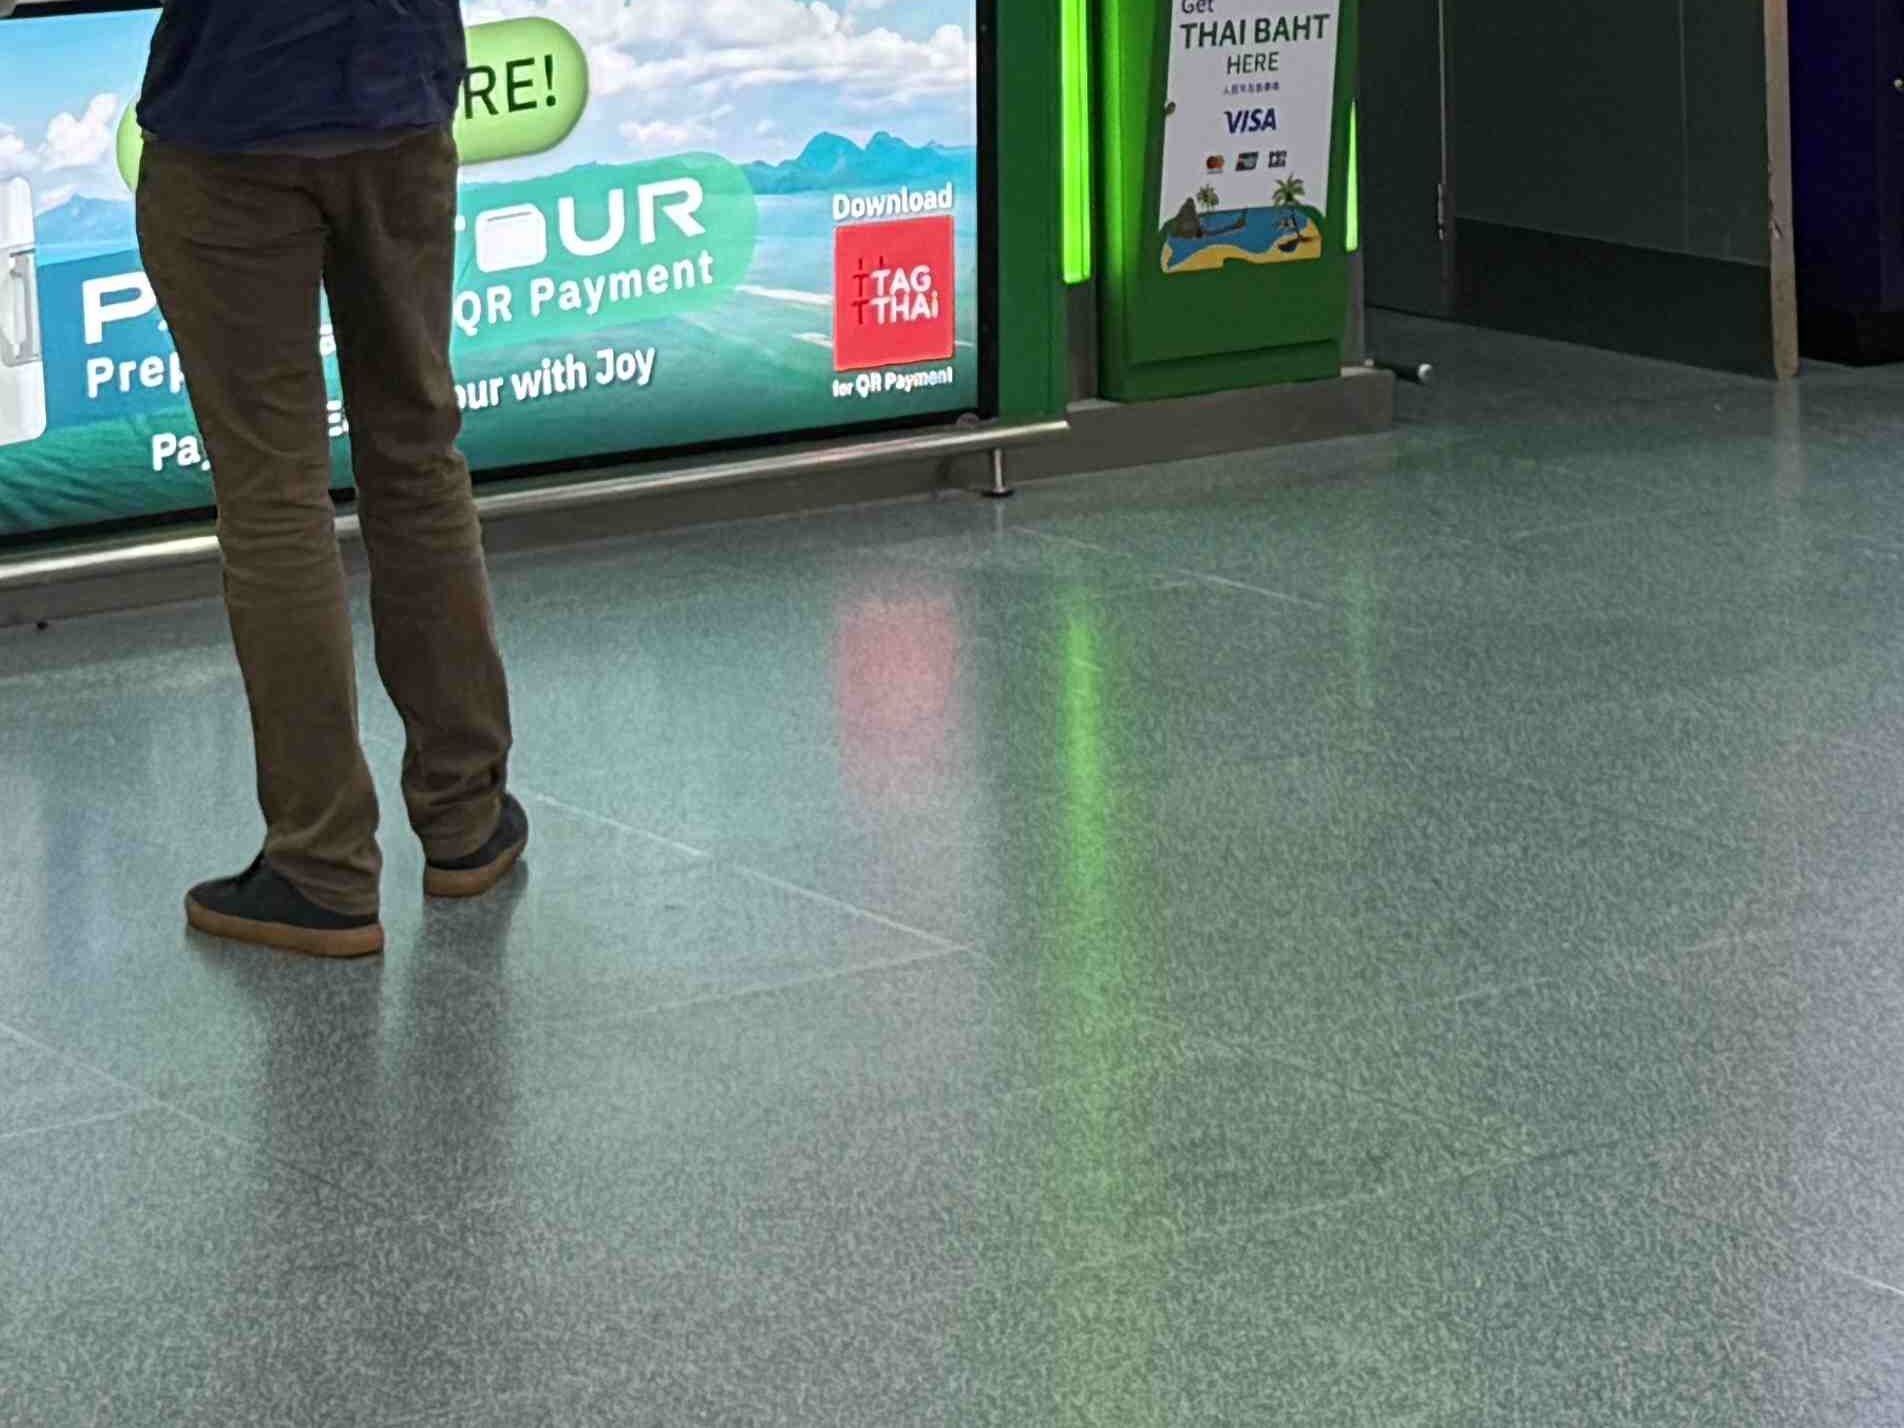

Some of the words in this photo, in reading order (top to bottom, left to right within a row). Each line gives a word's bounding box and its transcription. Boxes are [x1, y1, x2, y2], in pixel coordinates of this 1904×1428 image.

[1178, 18, 1247, 50] THAI
[1253, 13, 1331, 44] BAHT
[1226, 51, 1280, 75] HERE
[464, 54, 557, 120] RE!
[1223, 107, 1277, 135] VISA
[832, 181, 953, 221] Download
[454, 285, 513, 337] QR
[530, 249, 714, 317] Payment
[870, 264, 932, 297] TAG
[856, 372, 882, 399] QR
[884, 366, 953, 393] Payment
[151, 432, 211, 472] Pa
[511, 353, 588, 402] with
[595, 346, 656, 387] Joy
